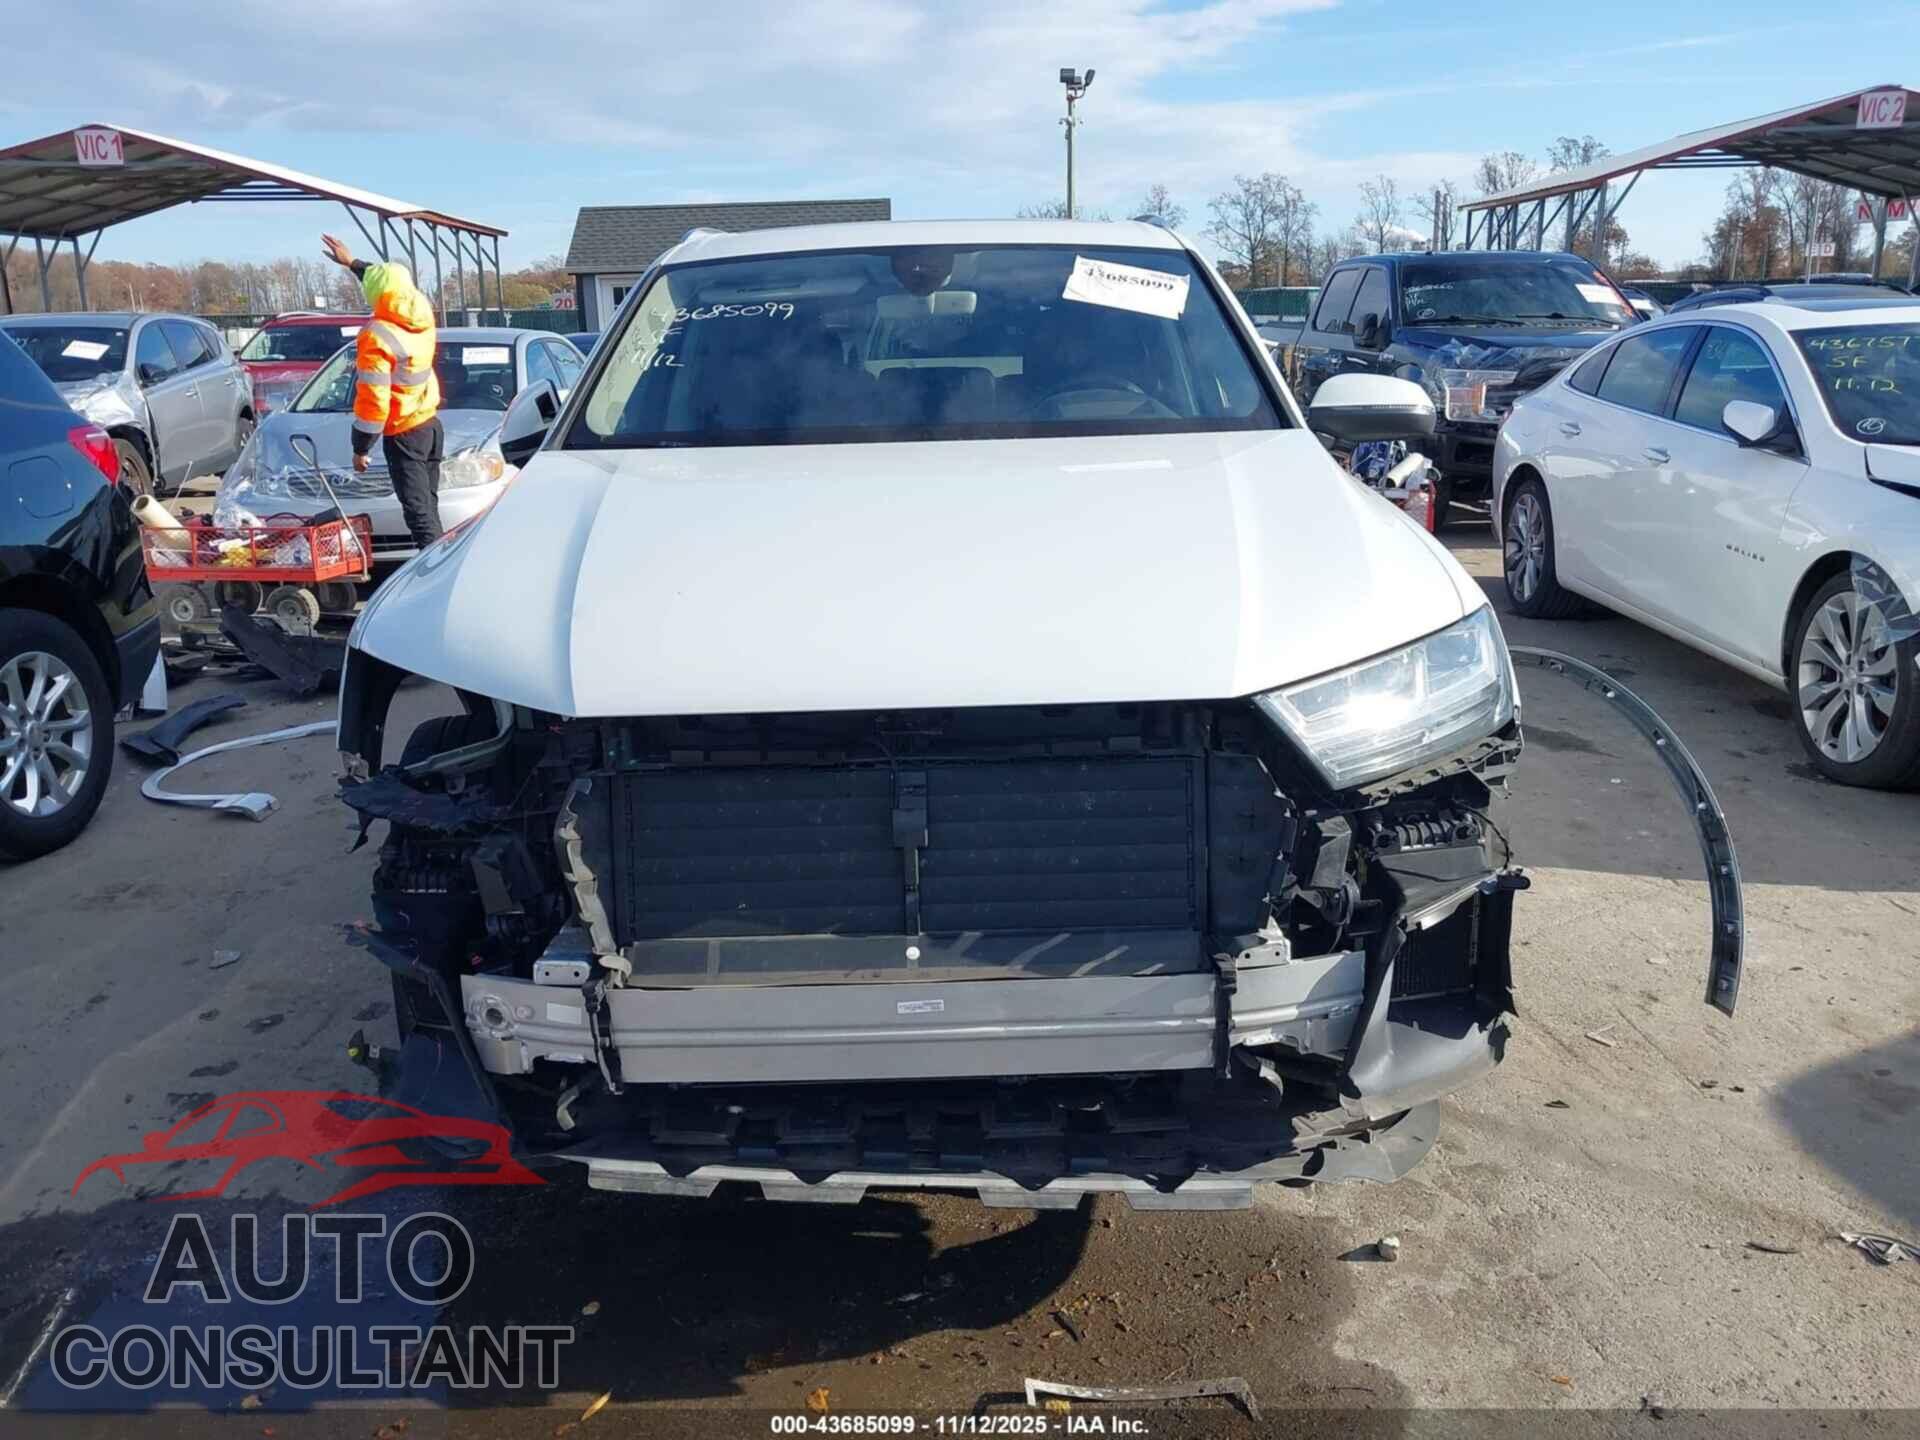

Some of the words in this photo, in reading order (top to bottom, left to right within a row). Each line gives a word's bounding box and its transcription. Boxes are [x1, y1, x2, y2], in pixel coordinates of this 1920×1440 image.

[1861, 96, 1889, 123] VIC
[1892, 96, 1904, 122] 2
[75, 134, 108, 161] VIC
[111, 134, 122, 161] 1
[1887, 202, 1905, 218] M
[650, 302, 794, 322] 43685099
[1826, 355, 1867, 368] SF
